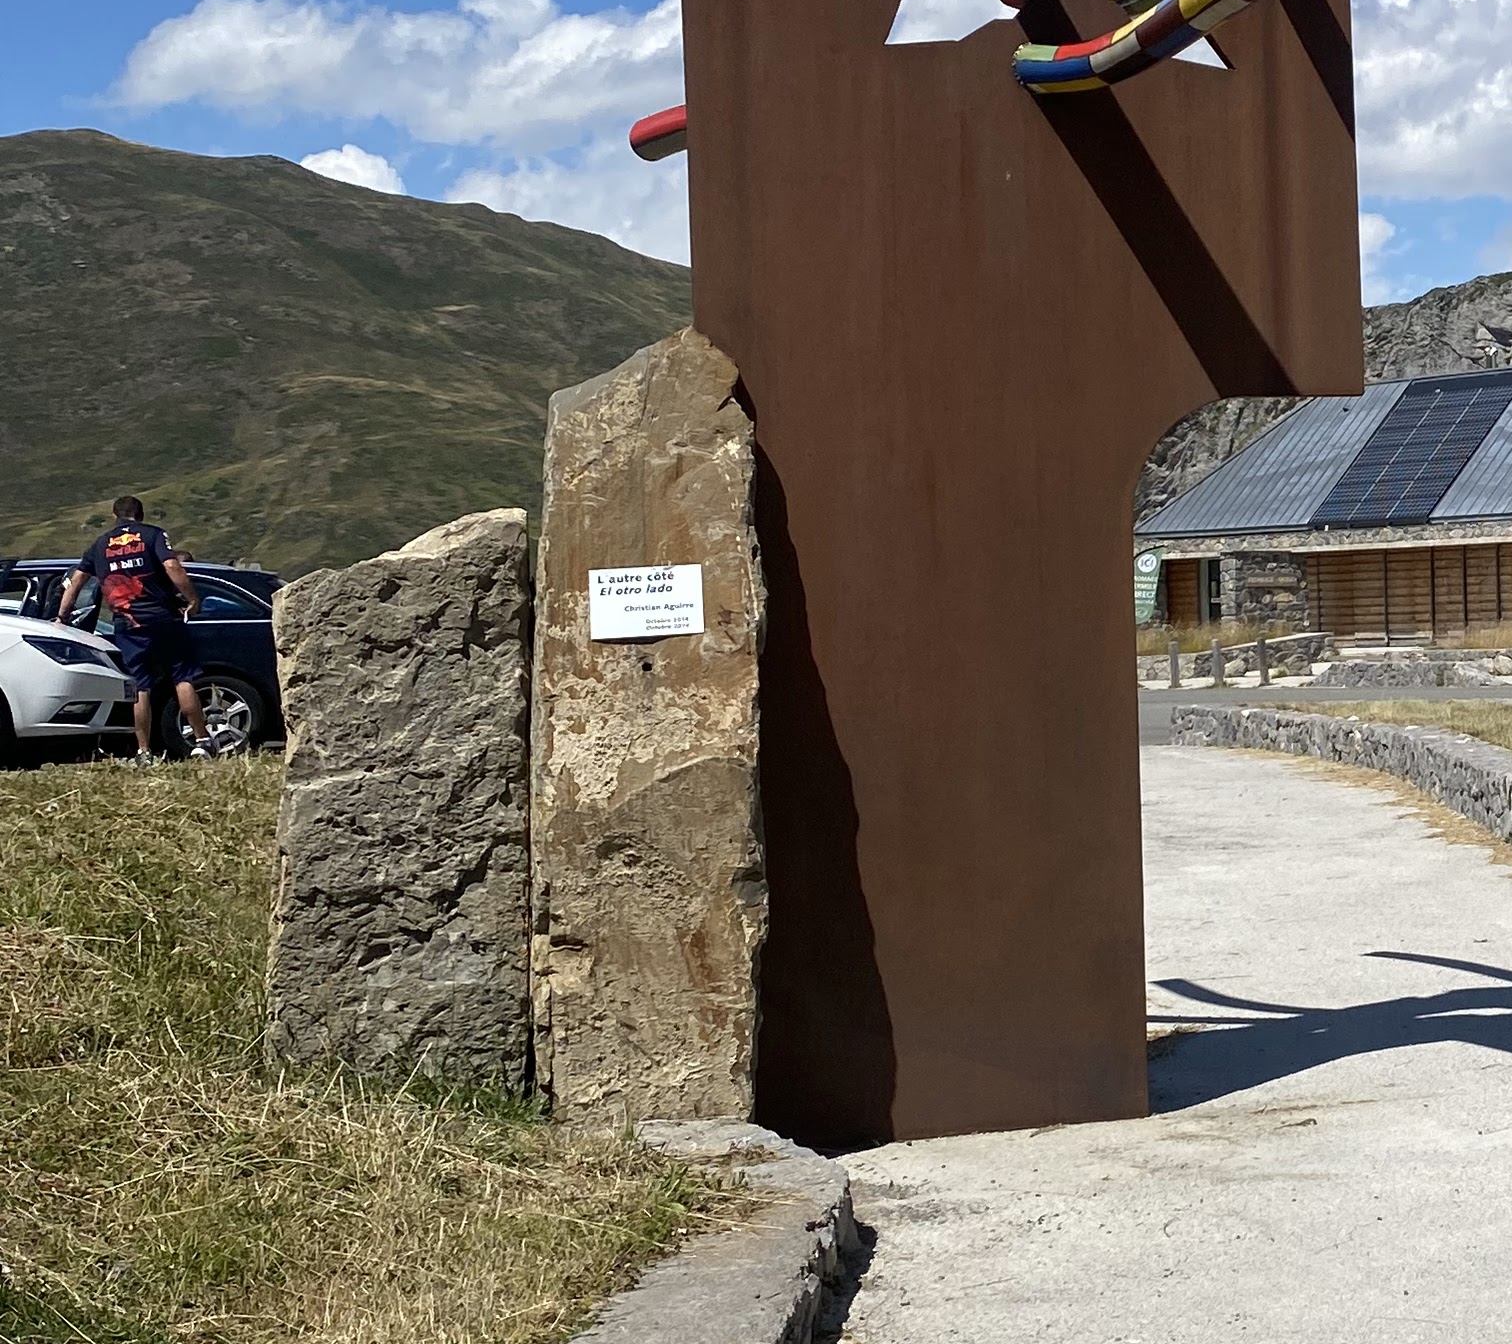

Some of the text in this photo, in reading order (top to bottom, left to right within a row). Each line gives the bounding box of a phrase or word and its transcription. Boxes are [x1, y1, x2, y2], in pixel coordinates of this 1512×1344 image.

[647, 571, 675, 582] côté
[600, 584, 673, 596] El otro lado
[624, 602, 694, 612] Christian Aguirre
